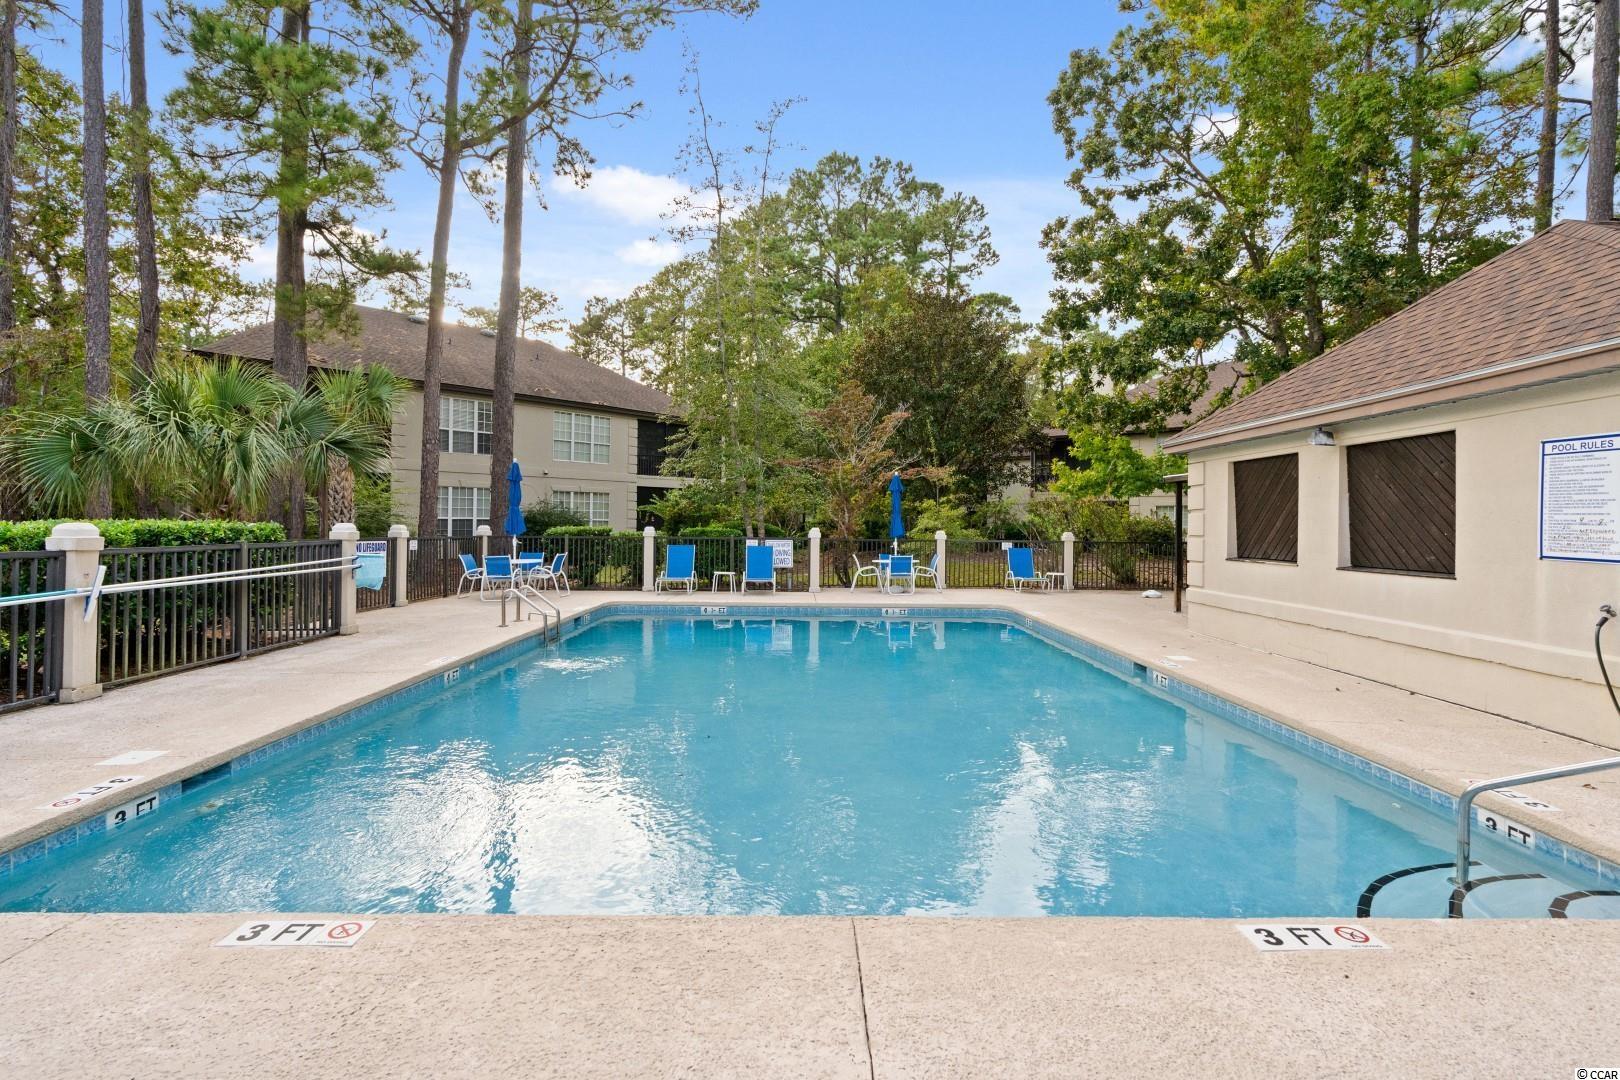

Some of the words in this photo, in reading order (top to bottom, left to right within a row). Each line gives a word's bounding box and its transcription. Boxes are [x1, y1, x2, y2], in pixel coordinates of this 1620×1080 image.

[1551, 443, 1577, 452] POOL
[1580, 440, 1614, 450] RULES
[363, 542, 386, 552] LIFEGUARD
[774, 557, 790, 565] LOWED
[115, 810, 127, 825] 3
[136, 796, 157, 816] FT
[1485, 817, 1497, 831] 3
[1508, 825, 1531, 845] FT
[236, 924, 270, 942] 3
[271, 924, 325, 942] FT
[1254, 928, 1284, 946] 3
[1286, 927, 1333, 946] FT
